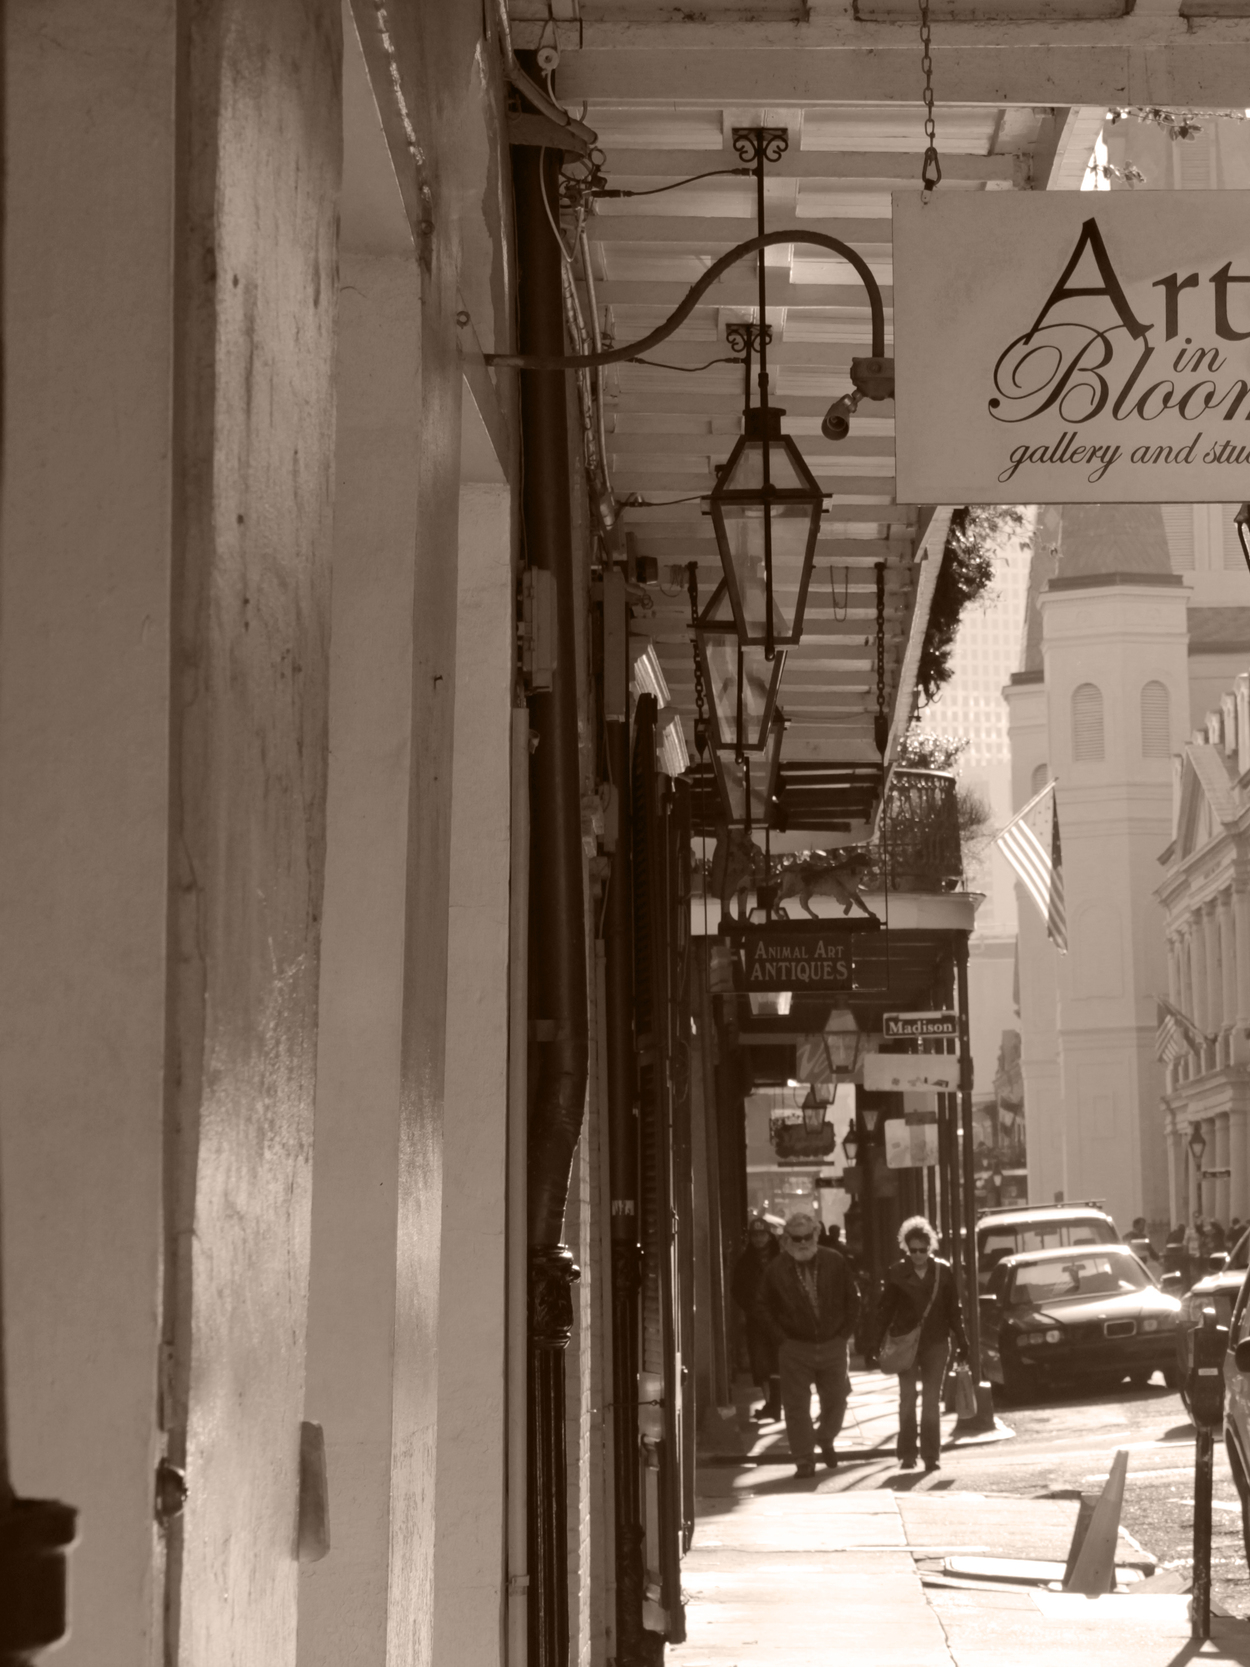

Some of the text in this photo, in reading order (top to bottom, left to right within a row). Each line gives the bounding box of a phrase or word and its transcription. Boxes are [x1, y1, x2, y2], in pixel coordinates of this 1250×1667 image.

[1173, 337, 1227, 374] in
[997, 431, 1123, 484] gallery
[1130, 432, 1203, 465] and
[750, 960, 849, 983] ANTIQUES
[888, 1020, 953, 1034] Madison
